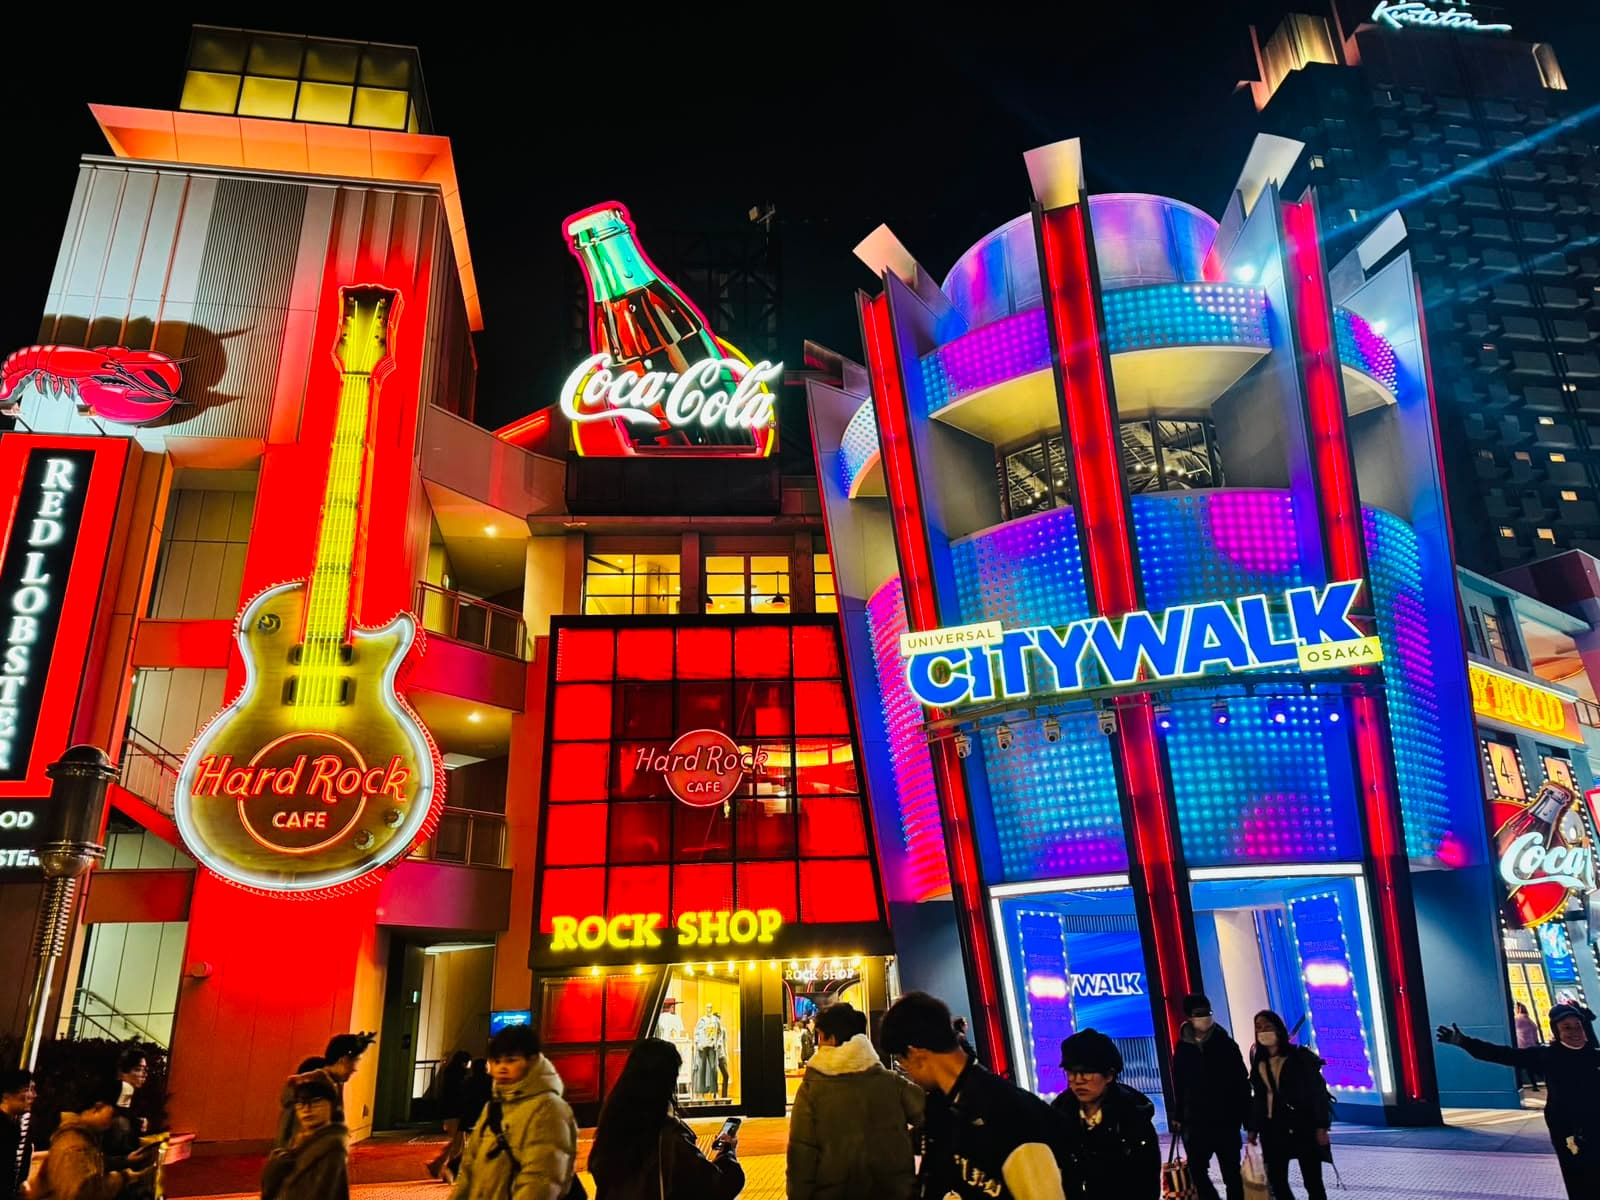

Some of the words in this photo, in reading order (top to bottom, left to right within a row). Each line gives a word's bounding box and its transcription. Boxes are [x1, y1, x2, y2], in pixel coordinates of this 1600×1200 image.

[560, 353, 784, 429] Coca-Cola
[27, 457, 76, 547] RED
[907, 628, 996, 649] UNIVERSAL
[908, 578, 1365, 706] CITYWALK
[1307, 644, 1374, 663] OSAKA
[635, 746, 701, 772] Hard
[706, 745, 769, 775] Rock
[191, 755, 308, 798] Hard
[306, 755, 412, 806] Rock
[686, 781, 721, 793] CAFE
[272, 811, 328, 829] CAFE
[550, 913, 662, 950] ROCK
[677, 909, 783, 945] SHOP
[785, 969, 818, 982] ROCK
[823, 967, 855, 980] SHOP
